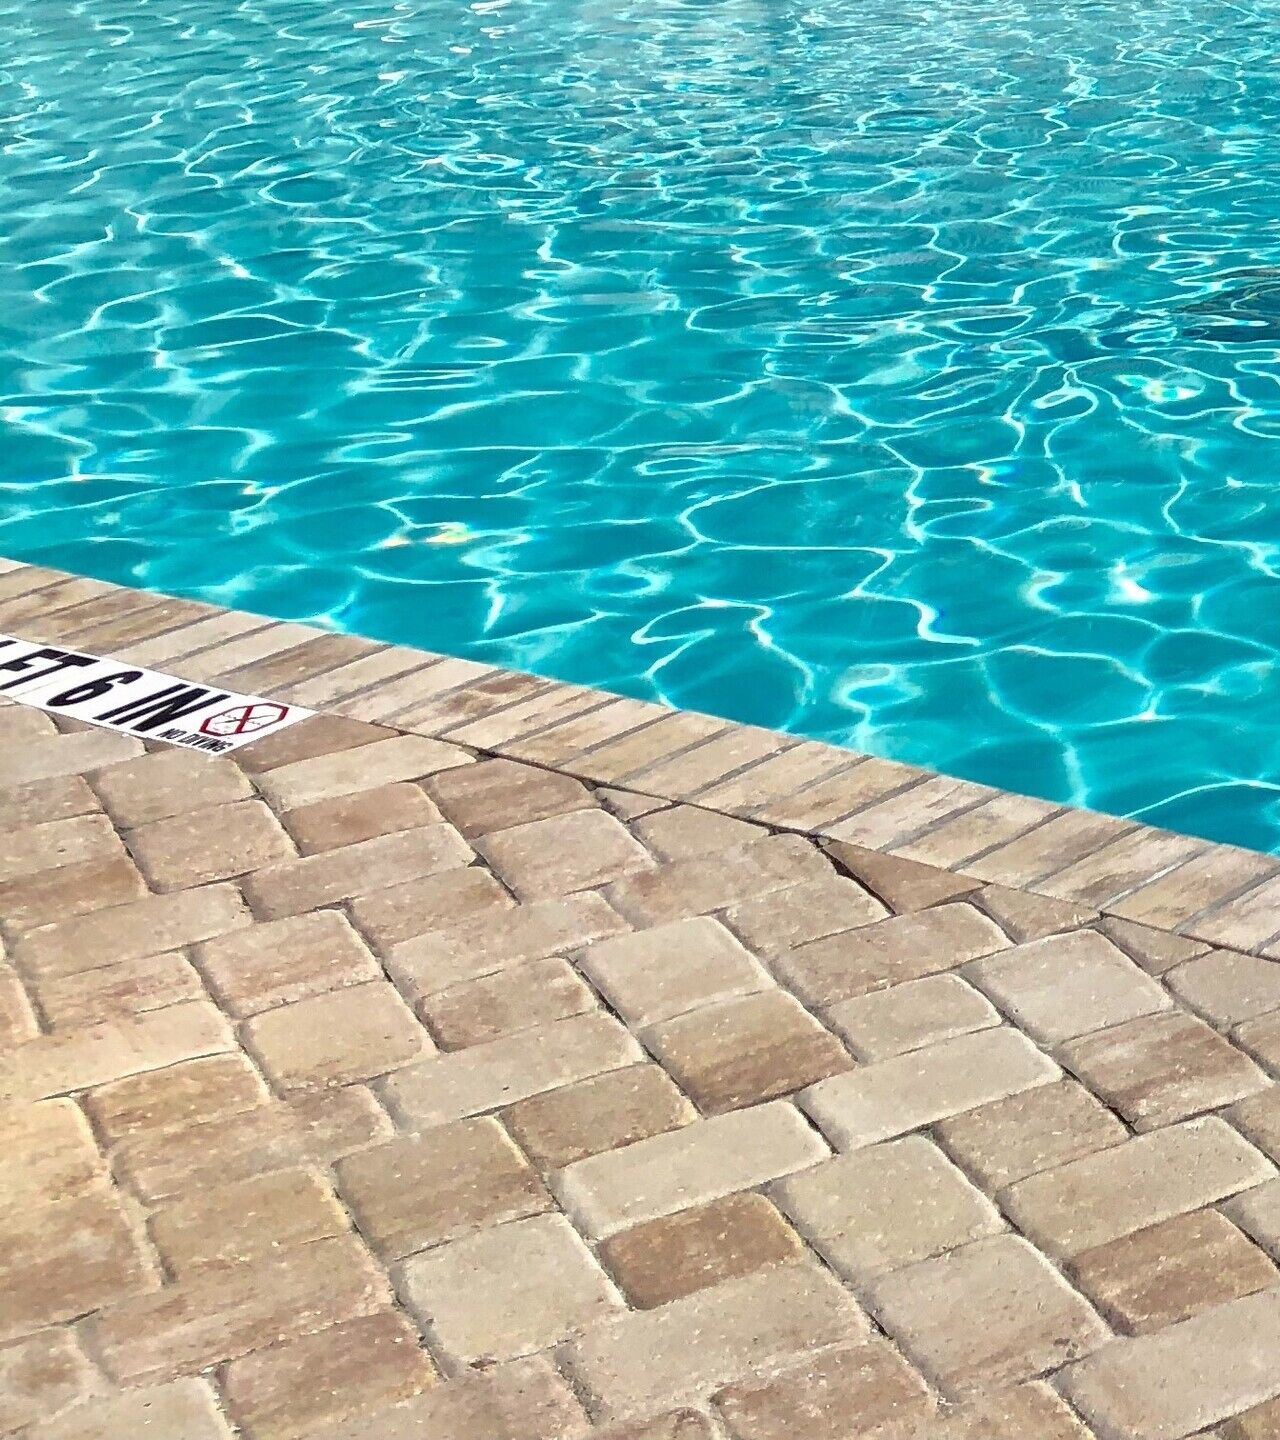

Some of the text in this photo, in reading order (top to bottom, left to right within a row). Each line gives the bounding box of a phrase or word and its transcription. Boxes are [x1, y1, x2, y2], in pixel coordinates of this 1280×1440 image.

[46, 670, 144, 707] 6
[92, 683, 231, 732] IN
[155, 727, 234, 752] NO DIVING
